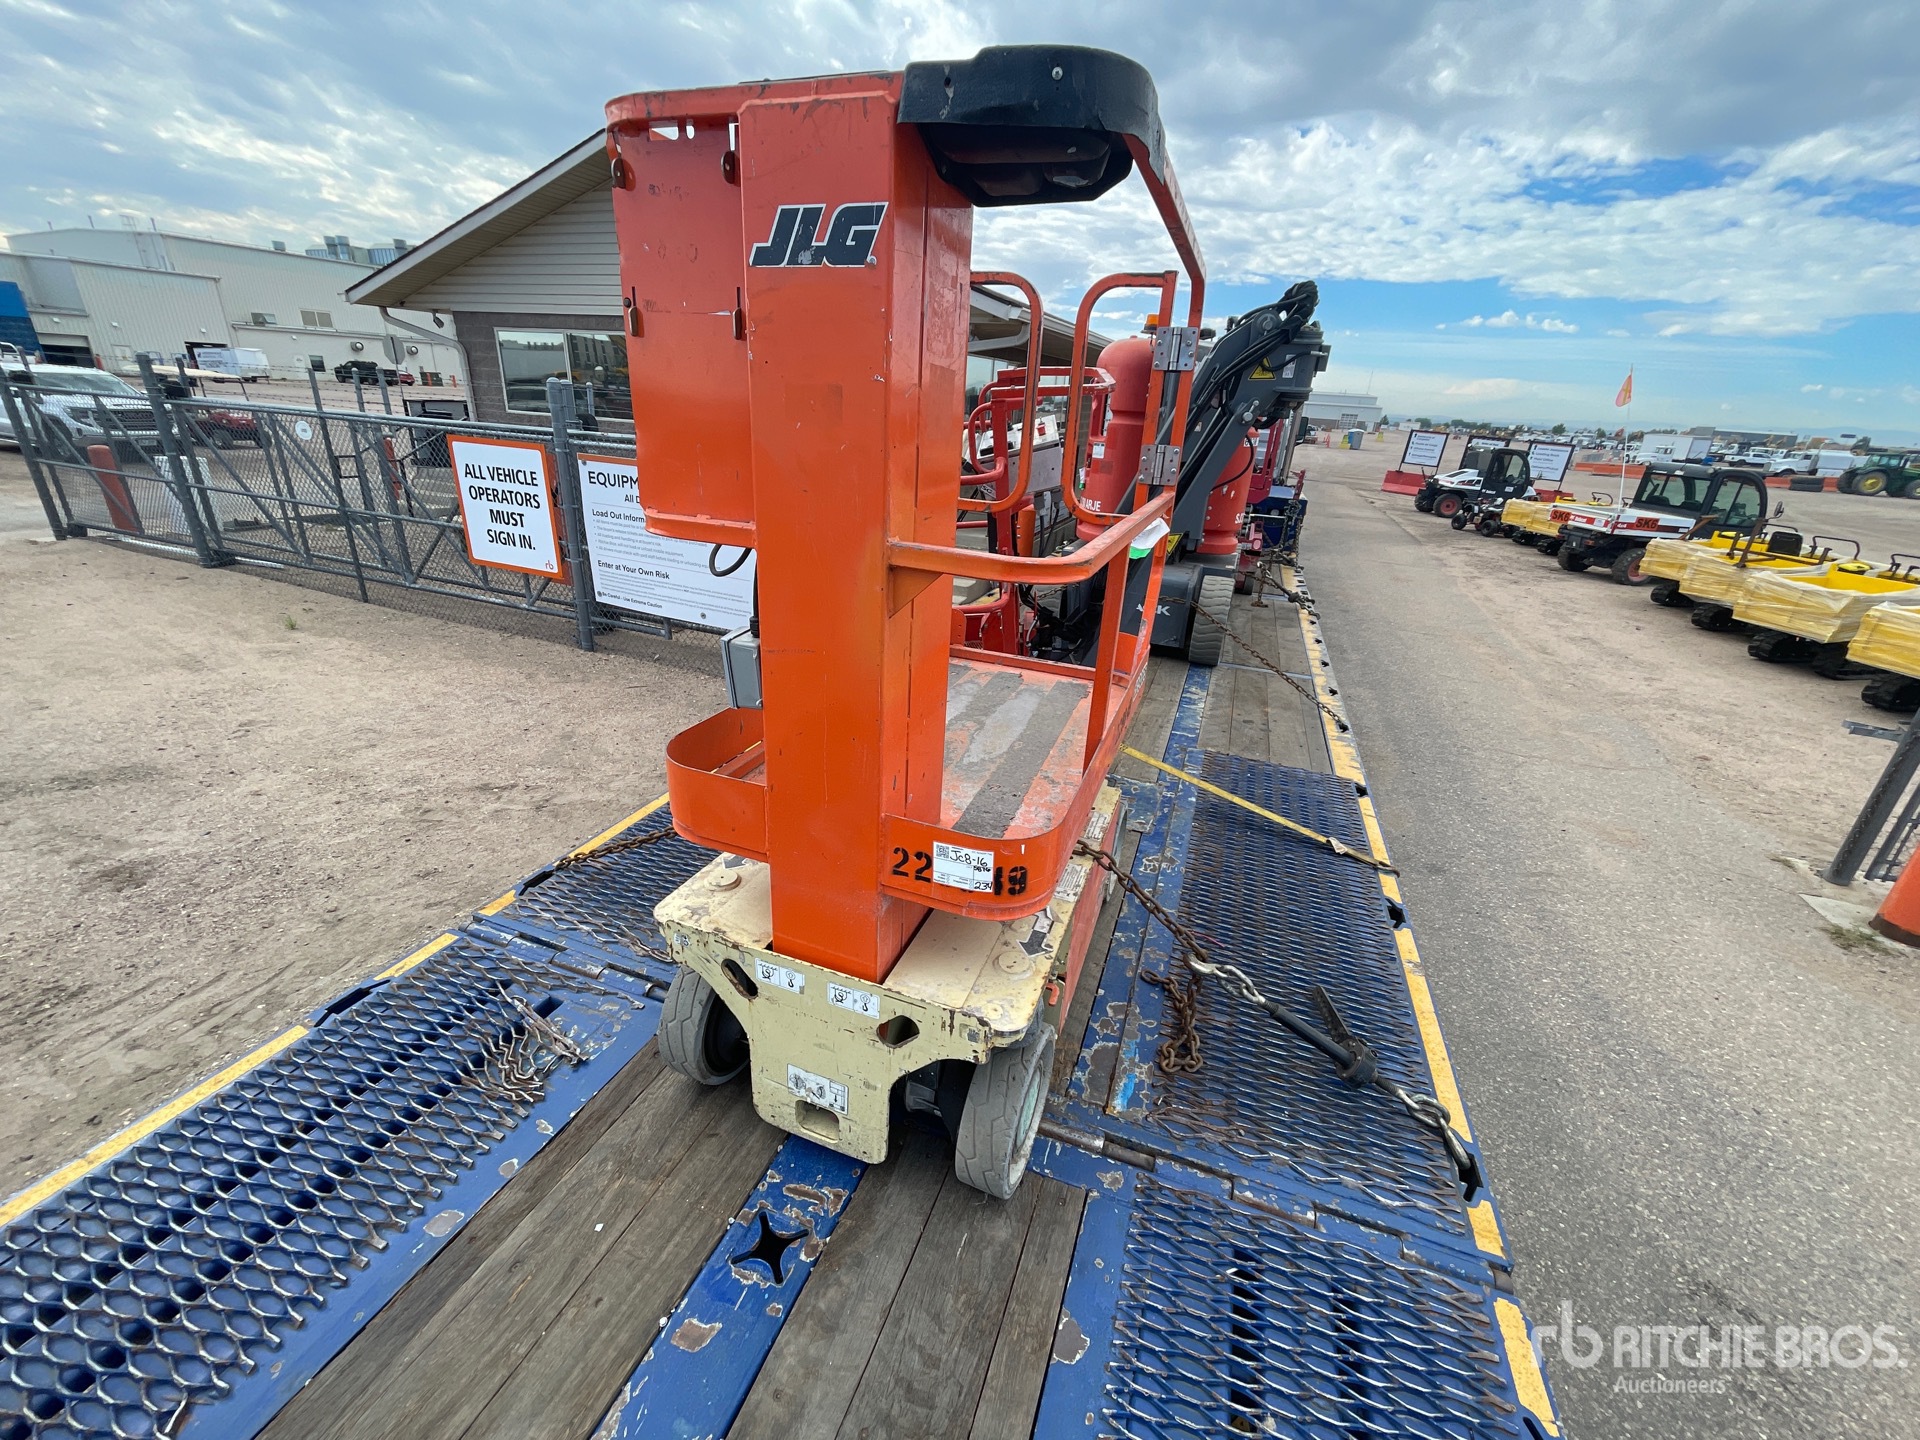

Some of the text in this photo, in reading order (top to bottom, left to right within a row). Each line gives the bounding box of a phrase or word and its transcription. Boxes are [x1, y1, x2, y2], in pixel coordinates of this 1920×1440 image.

[749, 201, 889, 268] JLG
[464, 463, 538, 487] ALL VEHICLE
[468, 485, 541, 509] OPERATORS
[624, 494, 634, 503] All
[489, 508, 524, 528] MUST
[592, 508, 608, 518] Load
[610, 511, 622, 520] Out
[1553, 511, 1570, 522] SK6
[1635, 517, 1658, 530] SK6
[486, 528, 536, 550] SIGN IN.
[598, 559, 614, 569] Enter
[622, 564, 637, 573] Your
[638, 567, 654, 577] Own
[656, 570, 670, 580] Risk
